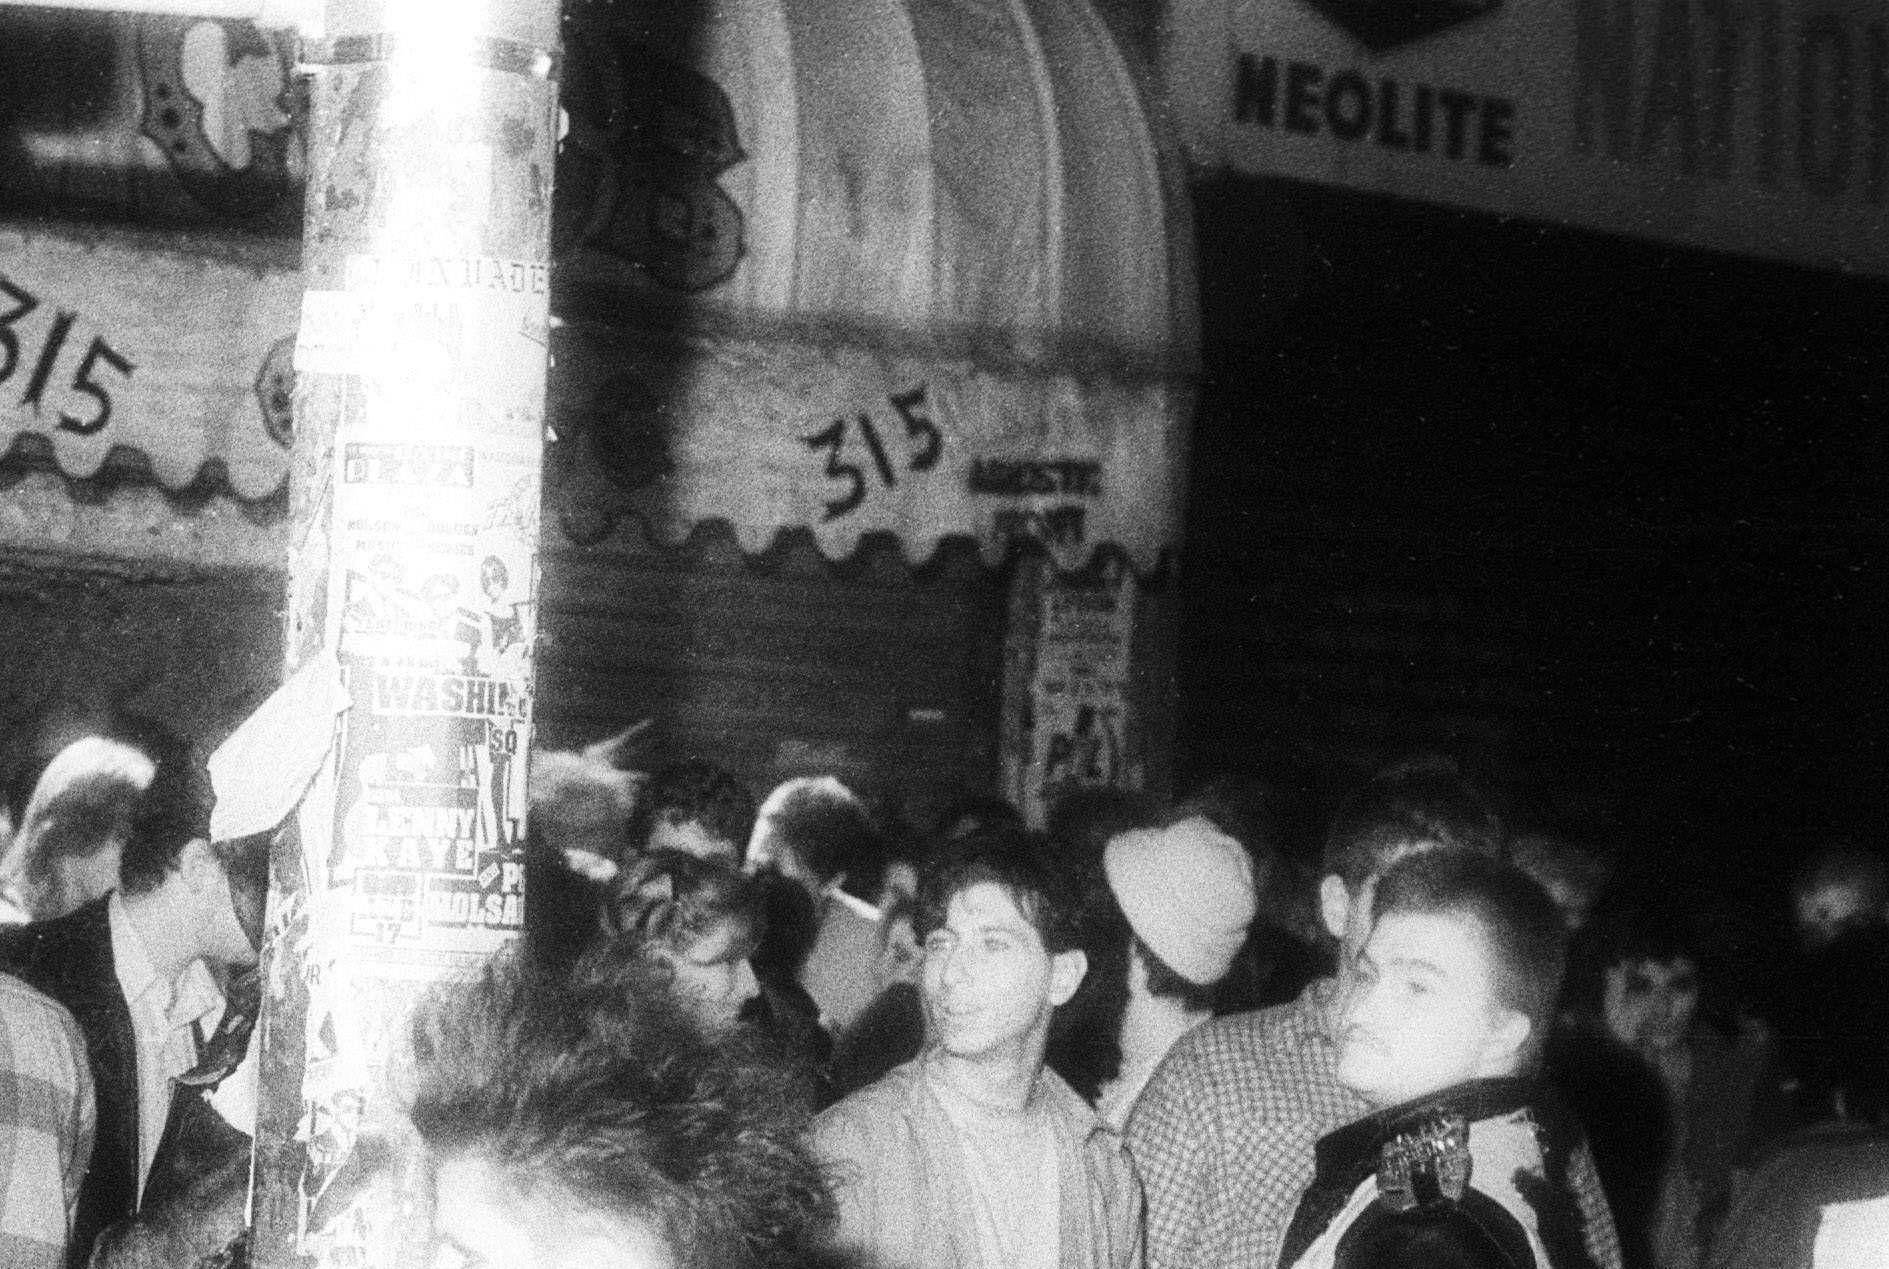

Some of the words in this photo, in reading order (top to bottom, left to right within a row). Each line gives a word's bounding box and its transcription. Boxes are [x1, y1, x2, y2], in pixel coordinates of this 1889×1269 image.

[1235, 52, 1514, 167] NEOLITE
[801, 382, 943, 522] 315
[364, 836, 474, 869] KAYE
[366, 805, 475, 839] LENNY
